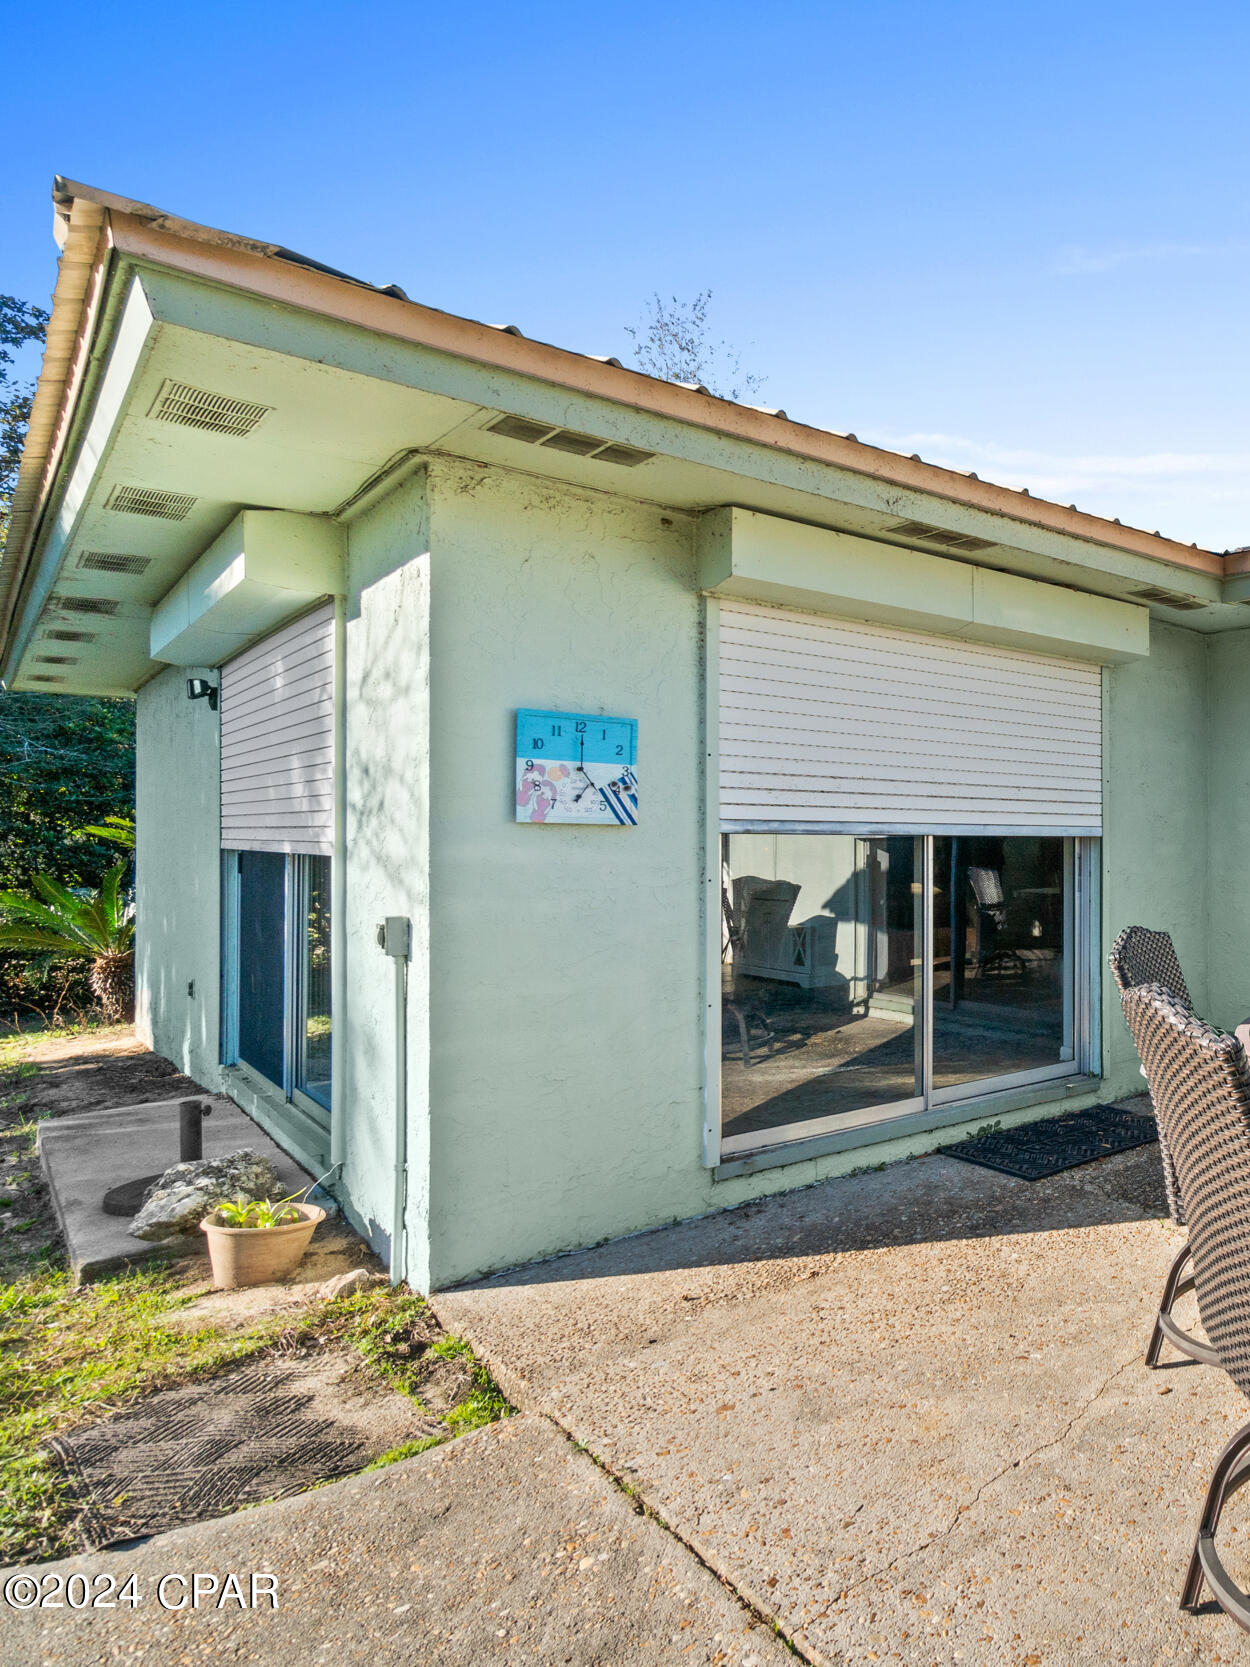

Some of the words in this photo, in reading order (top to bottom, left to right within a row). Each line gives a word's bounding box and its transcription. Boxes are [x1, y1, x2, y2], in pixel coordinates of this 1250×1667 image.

[552, 725, 562, 736] 11
[575, 721, 587, 733] 12
[602, 729, 606, 741] 1
[532, 738, 544, 749] 10
[615, 744, 623, 755] 2
[525, 760, 534, 772] 9
[621, 766, 630, 777] 3
[533, 780, 541, 792] 8
[550, 799, 557, 809] 7
[599, 800, 607, 812] 5
